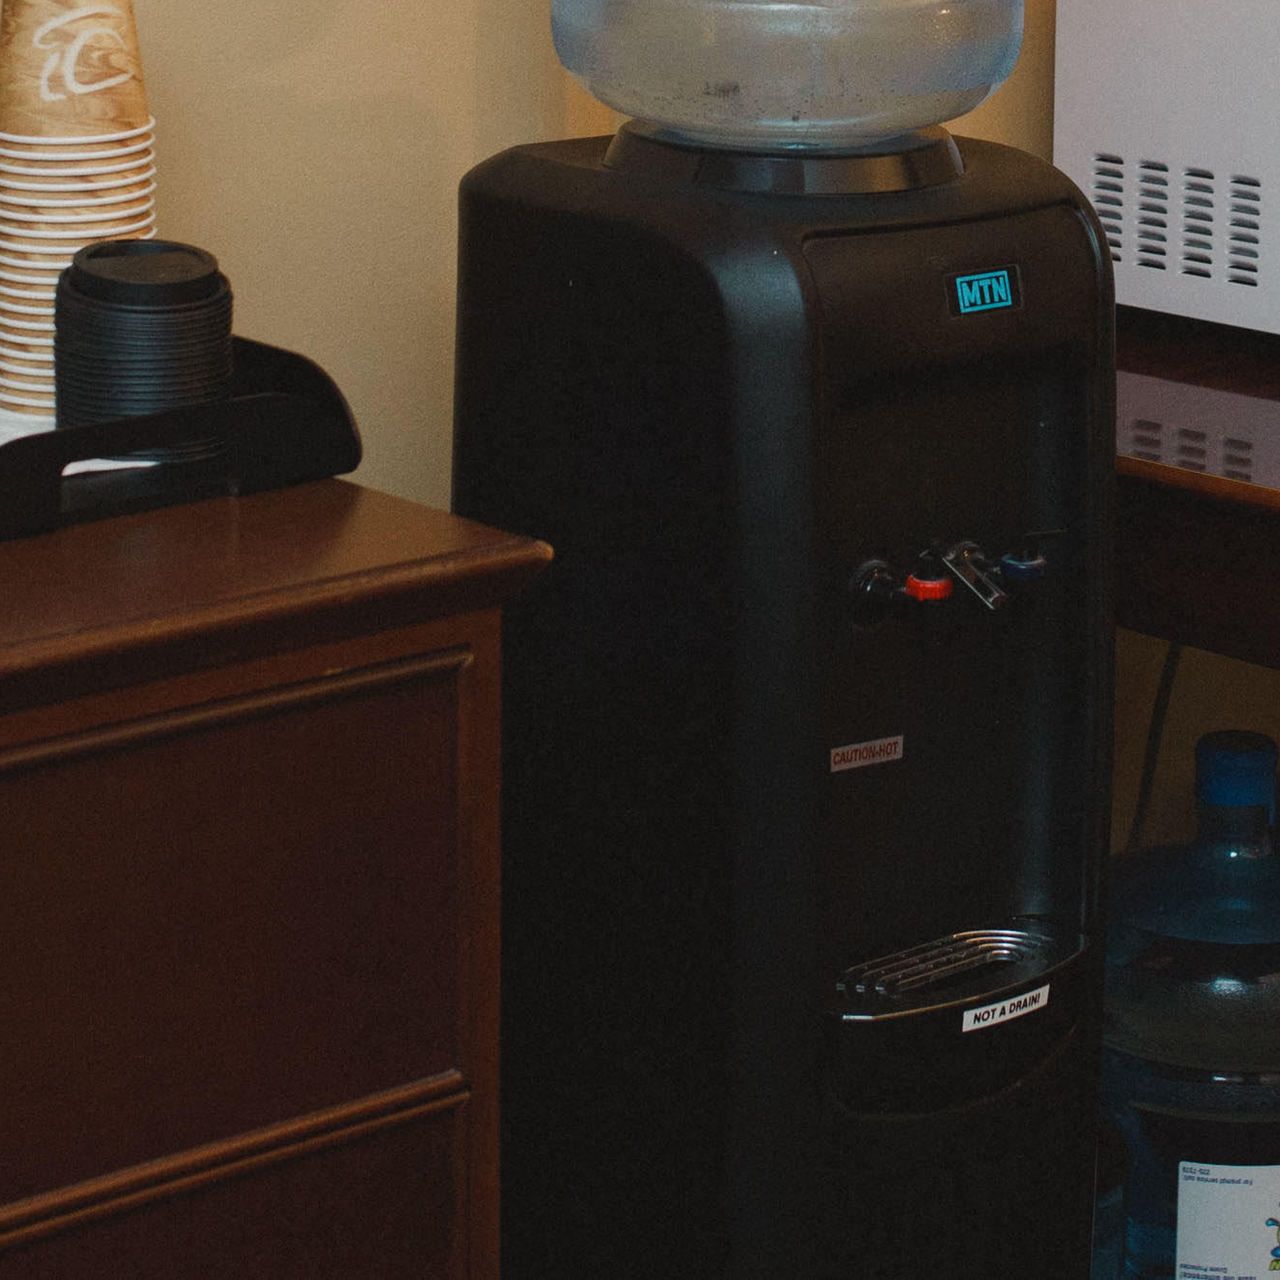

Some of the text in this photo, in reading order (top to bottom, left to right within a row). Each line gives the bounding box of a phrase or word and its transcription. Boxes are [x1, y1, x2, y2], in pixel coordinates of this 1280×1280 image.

[961, 276, 1007, 307] MTN
[973, 992, 1041, 1025] NOT A DRAIN!
